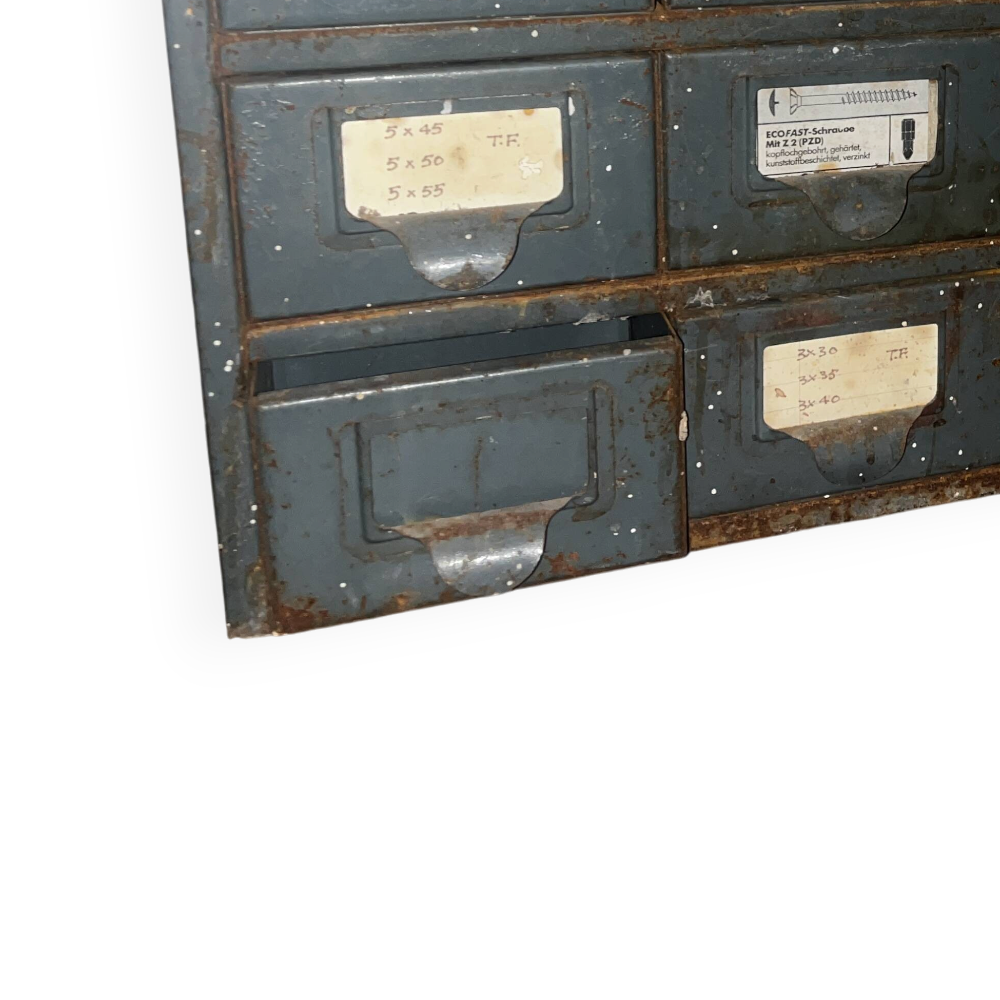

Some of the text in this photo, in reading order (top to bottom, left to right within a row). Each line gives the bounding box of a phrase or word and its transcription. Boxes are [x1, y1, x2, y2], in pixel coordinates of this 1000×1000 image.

[766, 140, 780, 148] Mit
[782, 139, 789, 147] Z
[799, 137, 824, 147] (PZD)
[766, 144, 861, 159] kopflochgebohrt, gehärtet,
[766, 151, 870, 167] kunststoffbeschichtet, verzinkt
